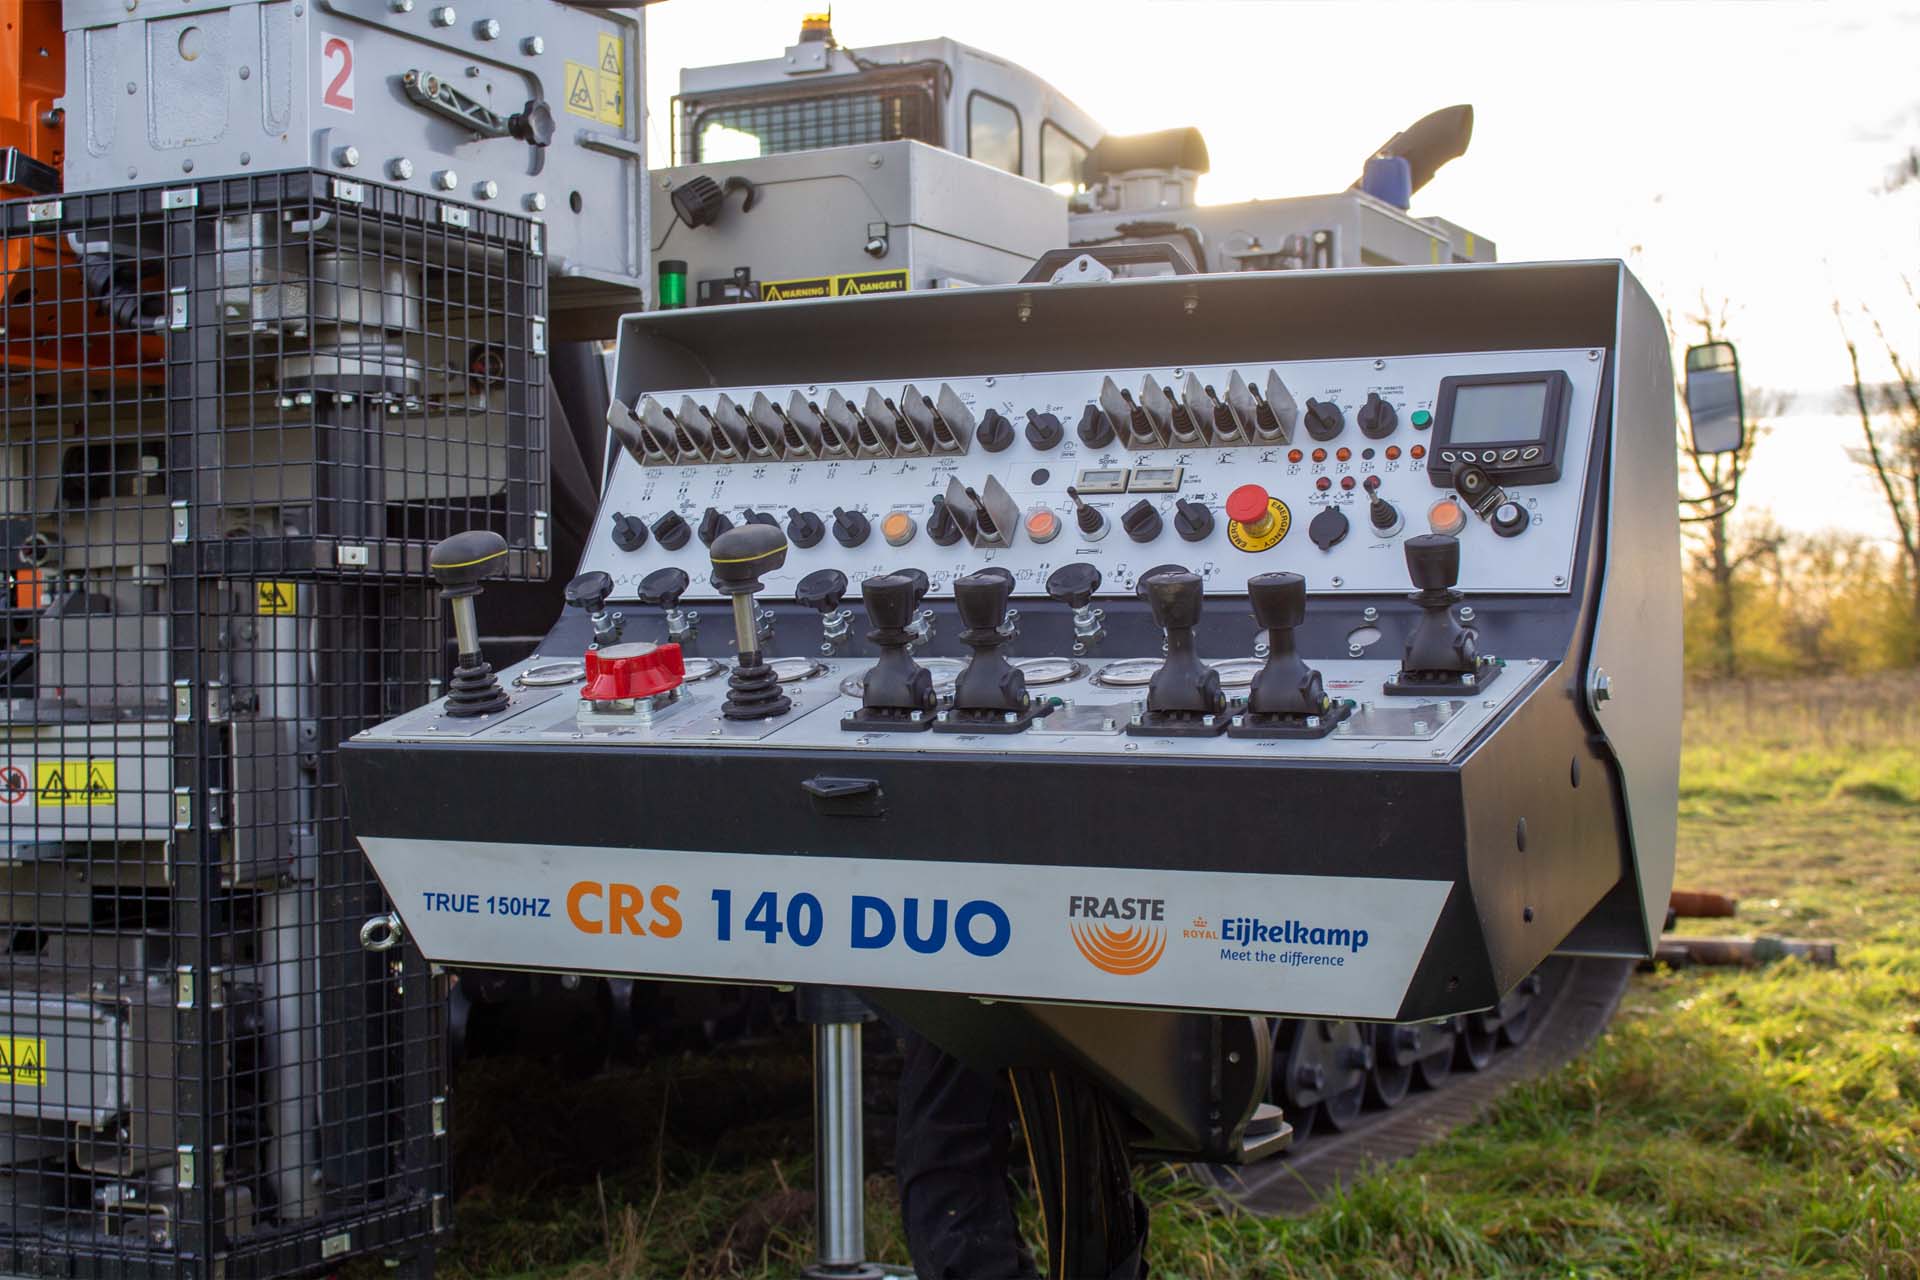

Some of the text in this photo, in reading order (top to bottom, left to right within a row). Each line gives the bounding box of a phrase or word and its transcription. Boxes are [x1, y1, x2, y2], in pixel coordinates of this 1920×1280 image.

[324, 38, 353, 111] 2
[781, 288, 824, 299] WARNING
[860, 281, 897, 292] DANGER
[1264, 501, 1288, 547] EMERGENCY
[423, 881, 1012, 958] TRUE 150HZ CRS 140 DUO
[1069, 895, 1165, 922] FRASTE
[1183, 917, 1369, 954] ROYAL Eijkelkamp
[1220, 949, 1345, 967] Meet the difference
